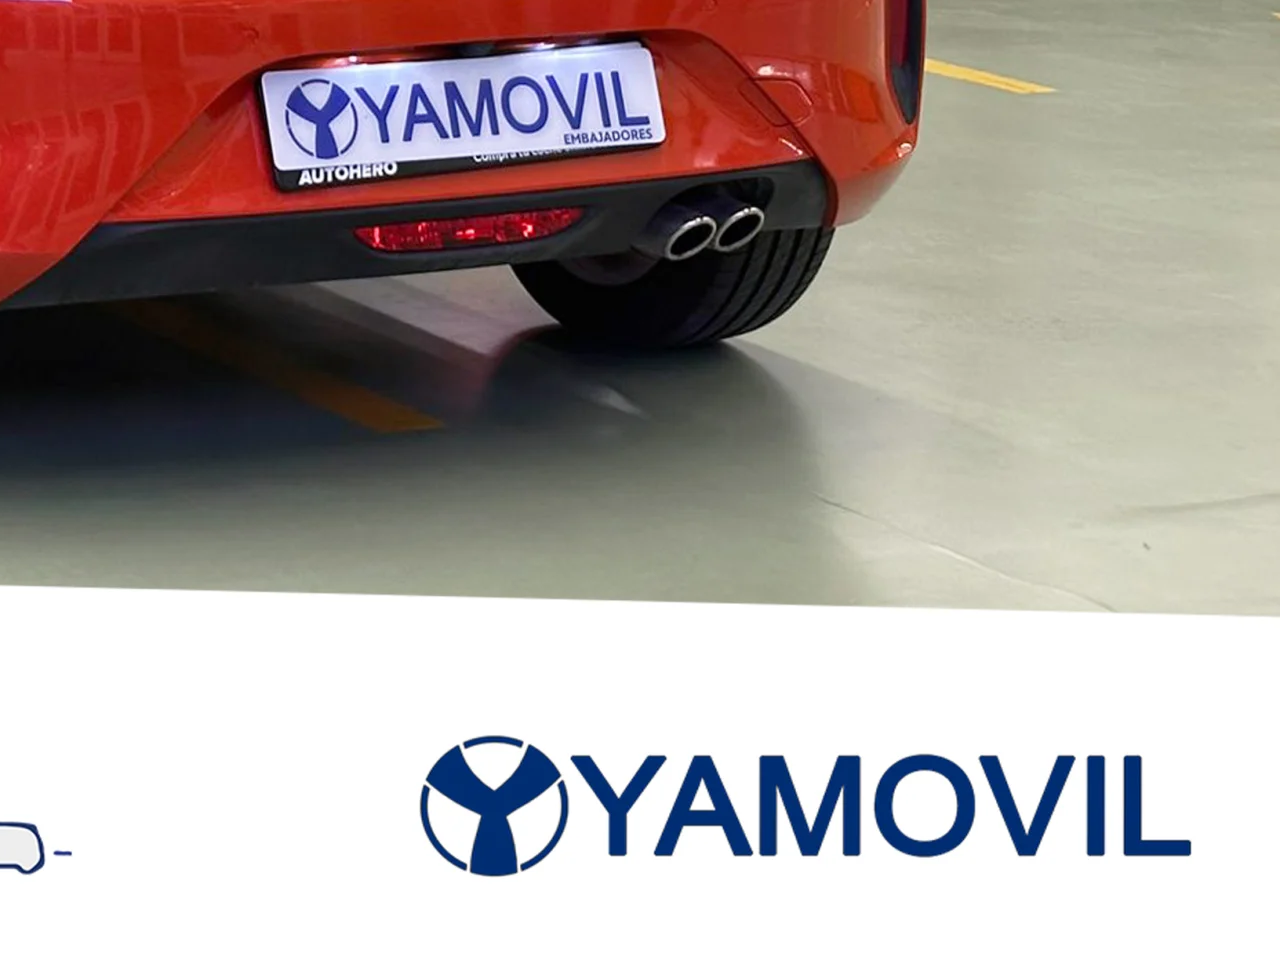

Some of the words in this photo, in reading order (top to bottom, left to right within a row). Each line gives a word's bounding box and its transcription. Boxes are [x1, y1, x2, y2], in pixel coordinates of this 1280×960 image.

[355, 70, 651, 144] YAMOVIL
[563, 127, 653, 146] EMBAJADORES
[298, 161, 398, 187] AUTOHERO
